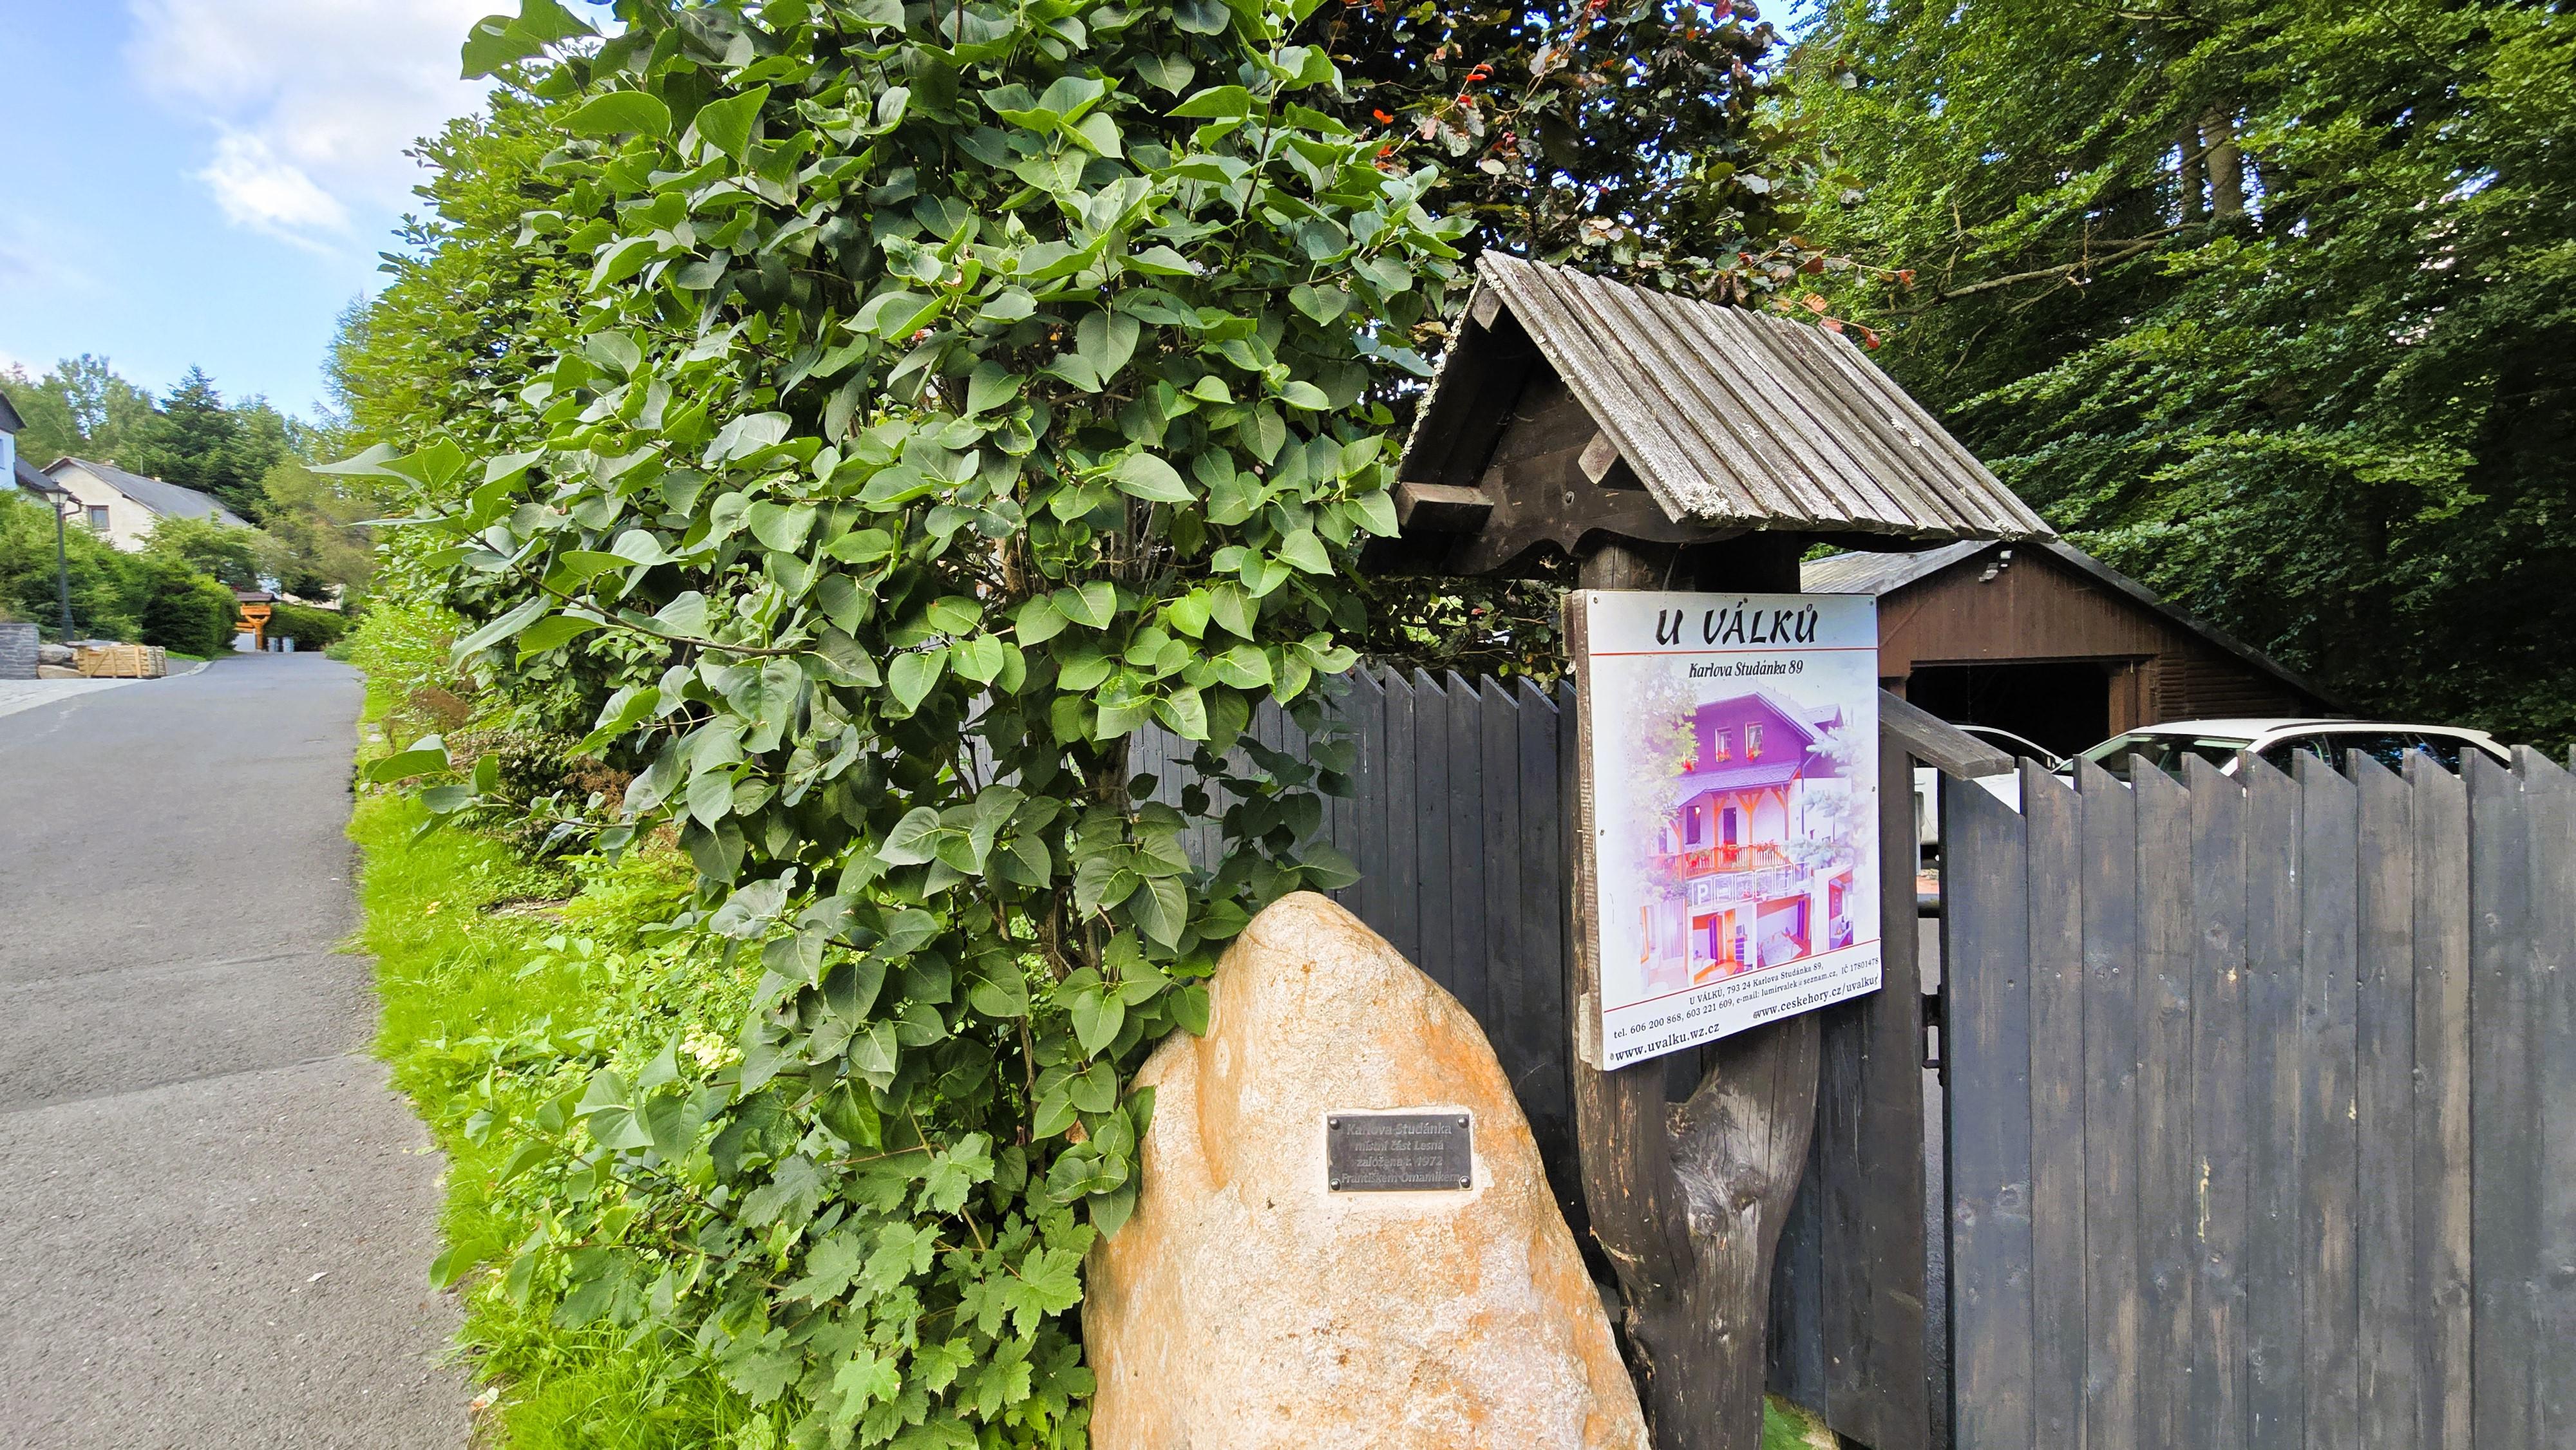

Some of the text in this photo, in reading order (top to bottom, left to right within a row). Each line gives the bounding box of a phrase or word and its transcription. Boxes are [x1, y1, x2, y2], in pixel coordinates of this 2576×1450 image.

[1655, 601, 1819, 646] U VÁLKŮ
[1689, 659, 1804, 679] Karlova Studánka 89
[1689, 962, 1824, 1005] U VÁLKŮ, 793 24 Karlova Studánka 89,
[1613, 1028, 1627, 1039] tel.
[1630, 1022, 1647, 1034] 606
[1649, 1018, 1664, 1030] 200
[1666, 1013, 1684, 1024] 868,
[1686, 1008, 1701, 1019] 603
[1703, 1003, 1716, 1014] 221
[1719, 998, 1735, 1009] 609,
[1736, 990, 1759, 1004] e-mail:
[1841, 963, 1848, 974] IČ
[1615, 1022, 1720, 1062] www.uvalku.wz.cz
[1347, 1122, 1452, 1135] Karlova Studánka
[1414, 1140, 1444, 1151] Lesná
[1417, 1156, 1443, 1167] 1972
